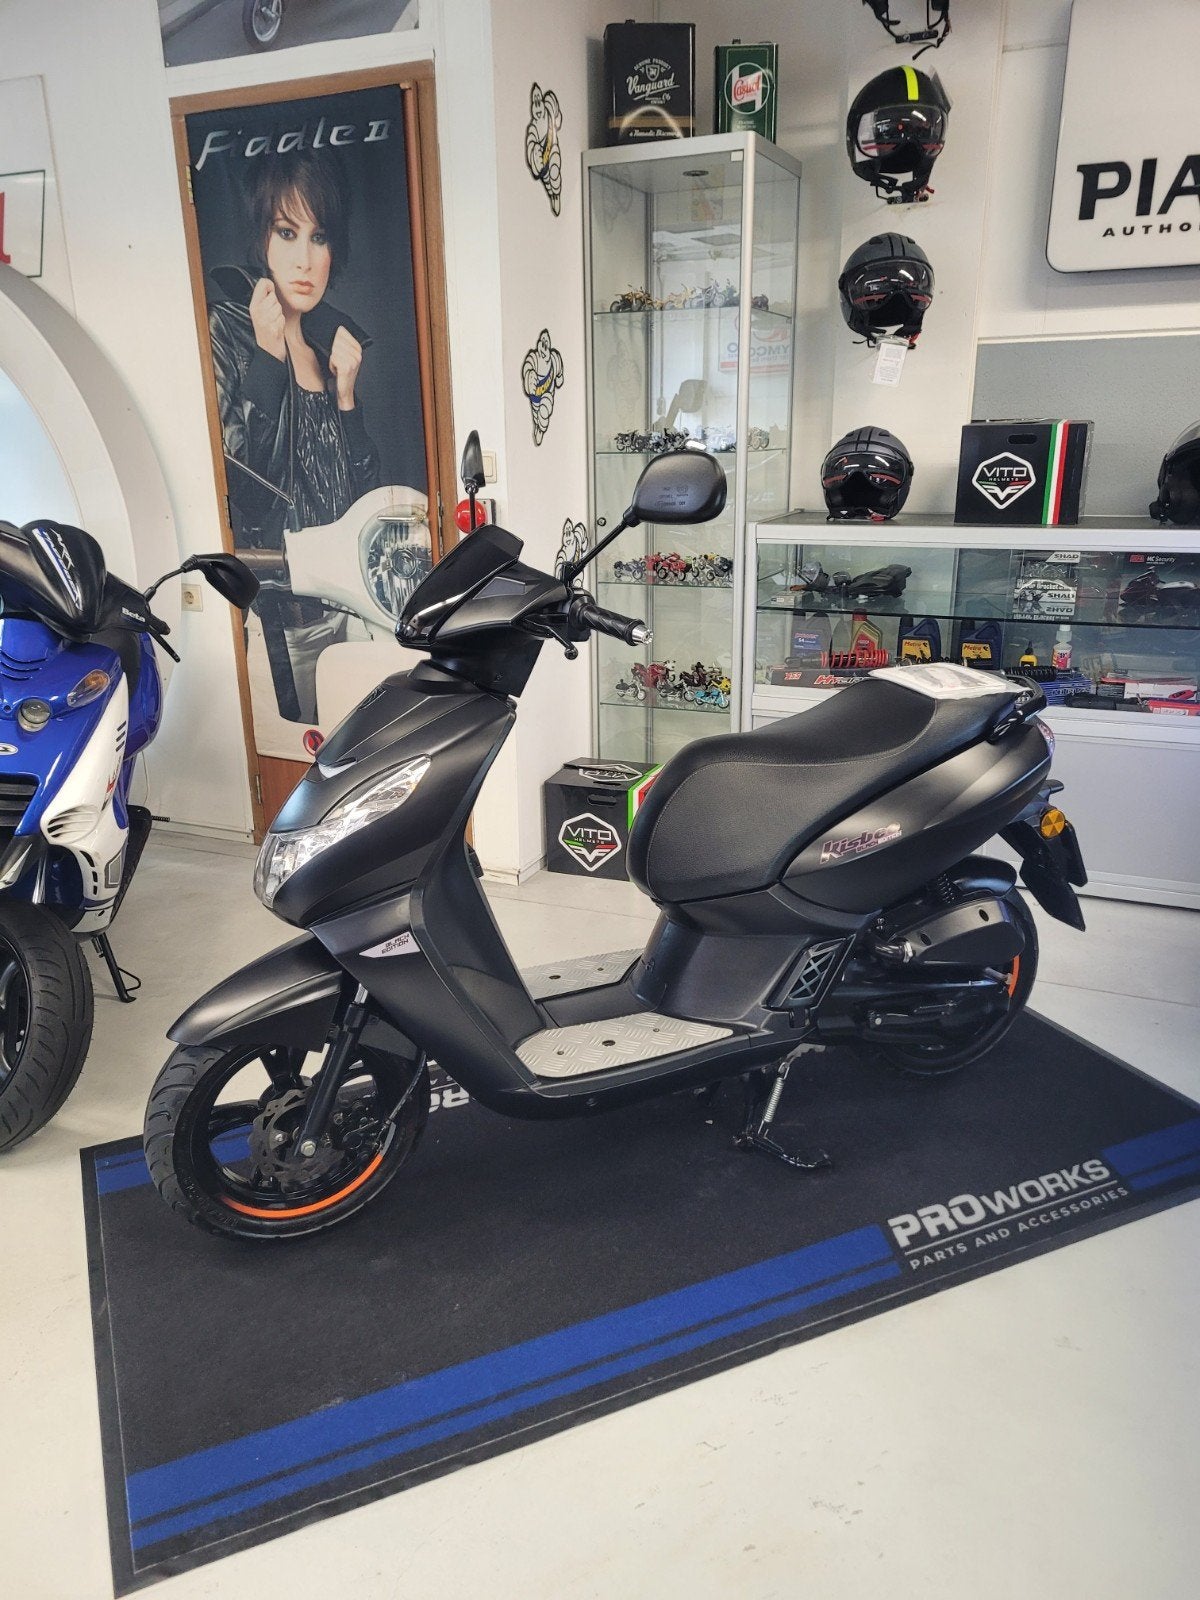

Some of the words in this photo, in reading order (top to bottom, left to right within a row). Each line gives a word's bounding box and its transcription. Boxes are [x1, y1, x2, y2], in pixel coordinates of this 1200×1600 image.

[626, 72, 676, 96] Vanguard
[1077, 154, 1200, 220] PIA
[1102, 222, 1200, 237] AUTHO
[983, 467, 1027, 477] VITO
[121, 606, 146, 623] Beta
[567, 826, 612, 841] VITO
[820, 823, 901, 864] Kisbe
[381, 939, 409, 954] EDITION
[909, 1243, 968, 1270] PARTS
[975, 1228, 1010, 1248] AND
[1018, 1187, 1129, 1232] ACCESSORIES
